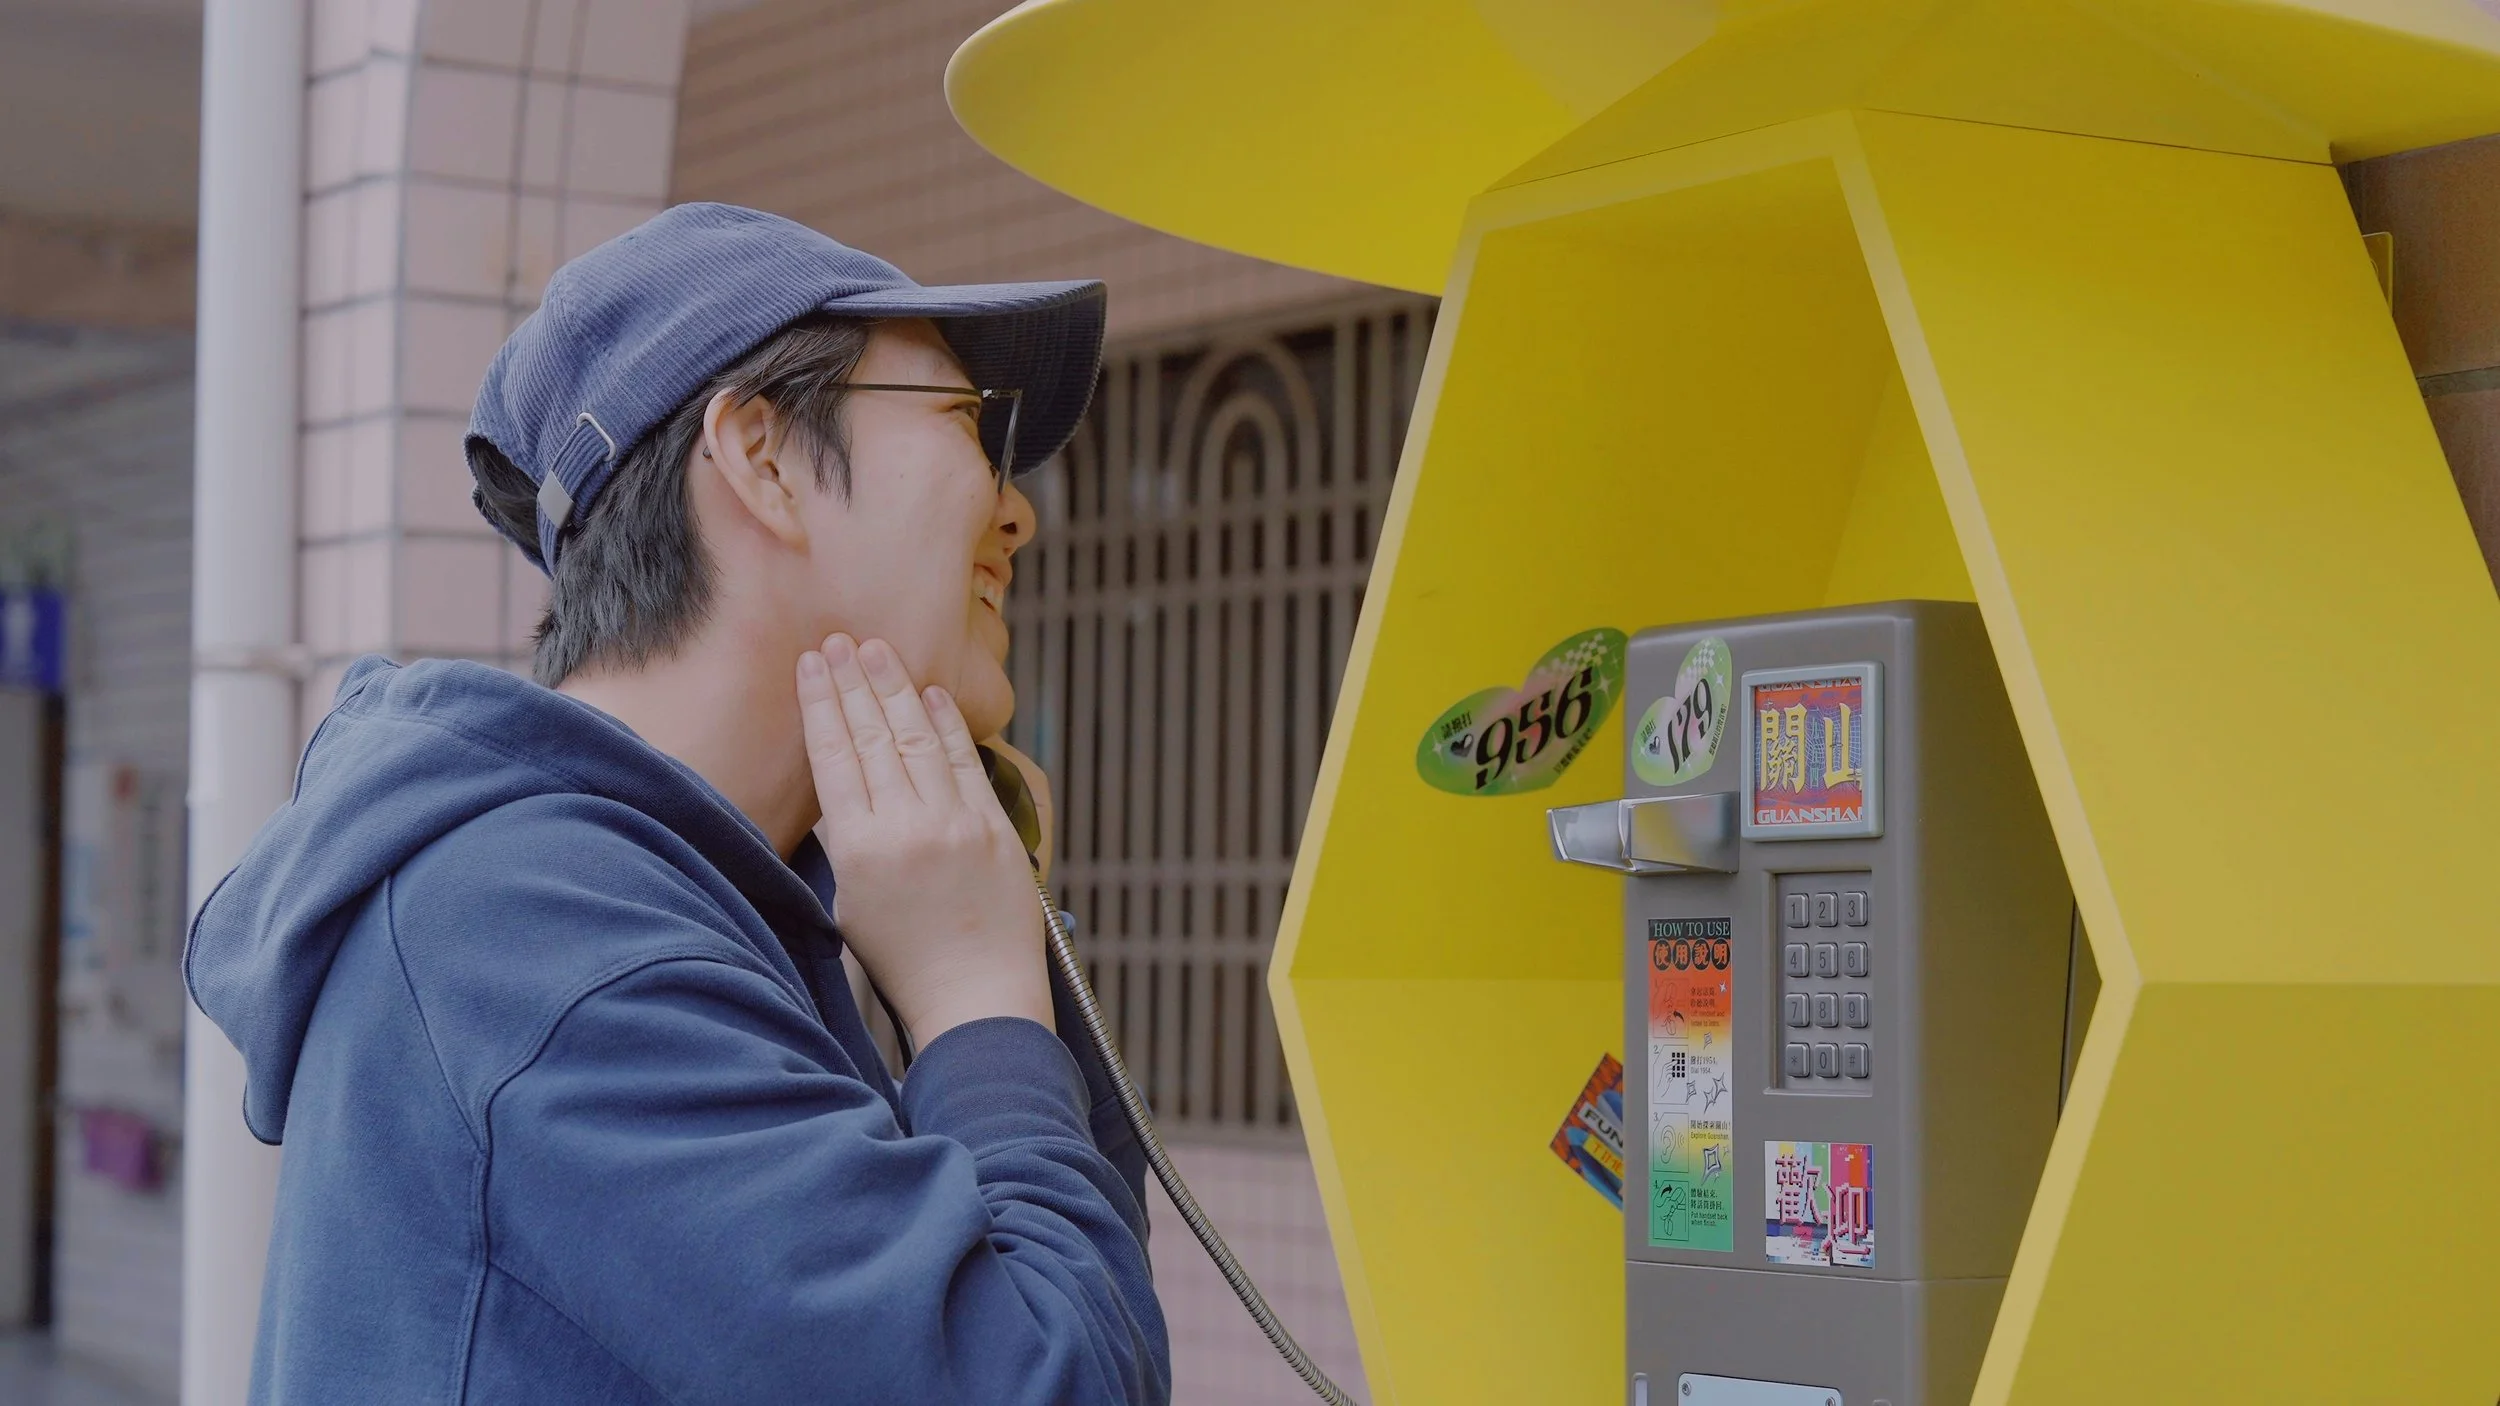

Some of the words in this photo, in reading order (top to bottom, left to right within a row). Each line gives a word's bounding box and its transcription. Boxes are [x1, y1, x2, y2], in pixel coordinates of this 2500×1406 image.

[1475, 666, 1593, 790] 956
[1667, 678, 1713, 774] 179
[1759, 702, 1863, 795] 關山
[1790, 901, 1797, 920] 1
[1818, 901, 1826, 919] 2
[1847, 900, 1856, 918] 3
[1654, 922, 1684, 937] HOW
[1686, 922, 1704, 937] TO
[1707, 921, 1730, 936] USE
[1654, 942, 1730, 968] 使用說明
[1790, 951, 1798, 969] 4
[1819, 951, 1827, 969] 5
[1847, 950, 1856, 969] 6
[1791, 1001, 1798, 1019] 7
[1819, 1001, 1827, 1019] 8
[1848, 1000, 1856, 1019] 9
[1819, 1052, 1828, 1069] 0
[1690, 1132, 1707, 1140] Explore
[1775, 1153, 1871, 1257] 歡迎
[1691, 1211, 1699, 1219] Put
[1699, 1211, 1717, 1219] handset
[1717, 1212, 1728, 1220] back
